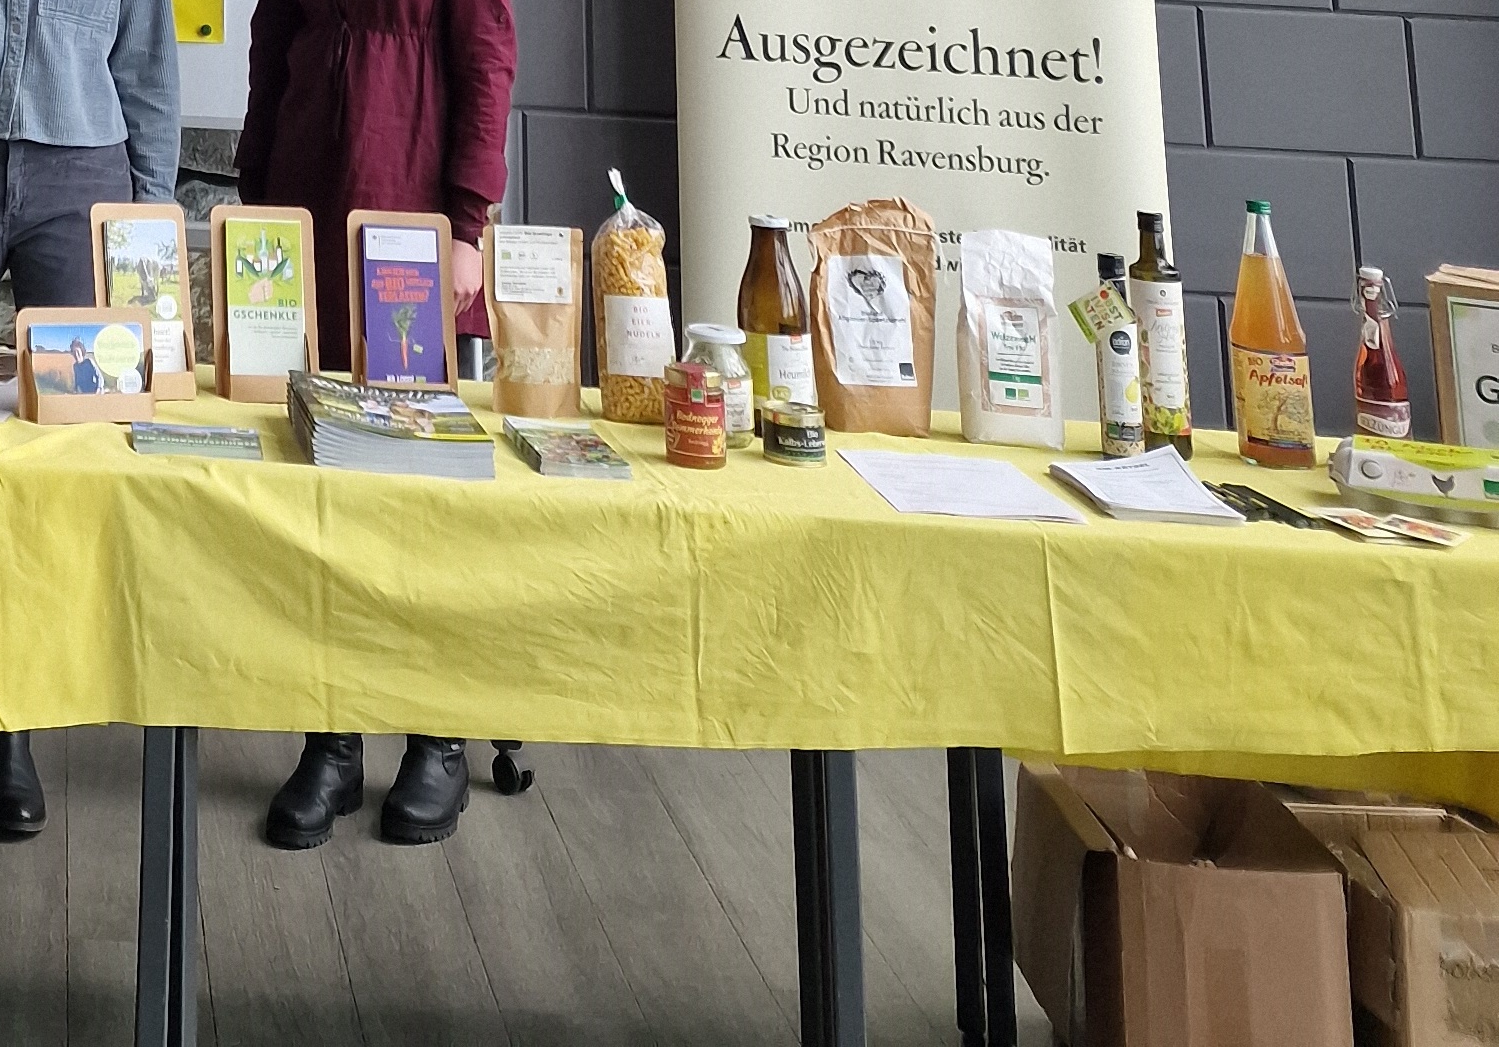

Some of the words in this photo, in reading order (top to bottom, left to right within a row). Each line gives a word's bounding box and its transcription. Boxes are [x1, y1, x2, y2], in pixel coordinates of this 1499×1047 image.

[716, 12, 1105, 86] Ausgezeichnet!
[786, 86, 851, 118] Und
[858, 93, 990, 128] natürlich
[998, 107, 1046, 132] aus
[1052, 102, 1104, 136] der
[771, 130, 870, 172] Region
[876, 138, 1051, 187] Ravensburg.
[233, 309, 298, 321] GSCHENKLE
[278, 298, 297, 308] BIO
